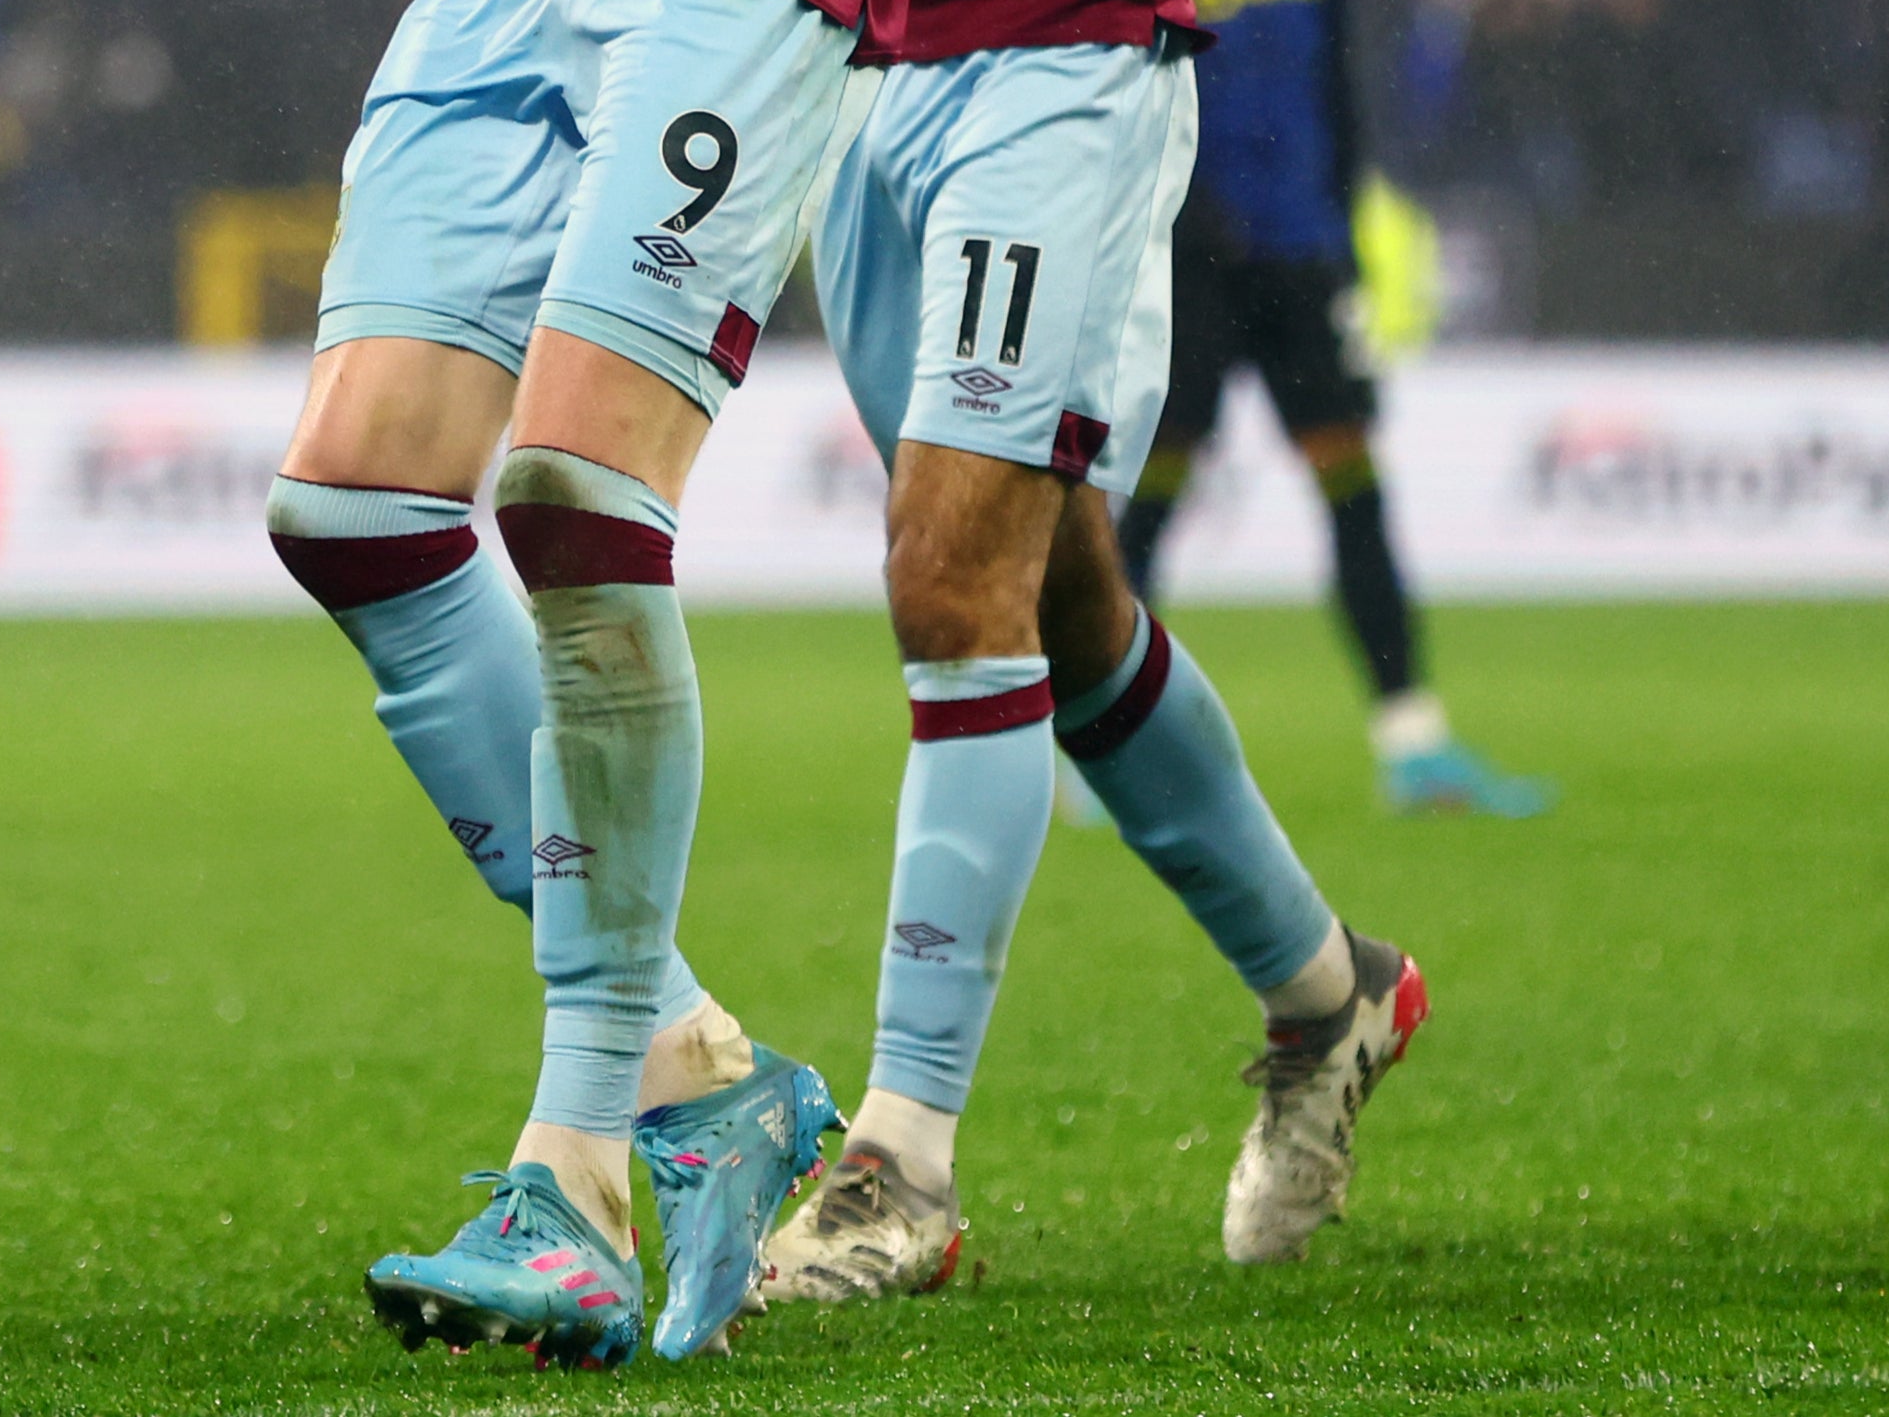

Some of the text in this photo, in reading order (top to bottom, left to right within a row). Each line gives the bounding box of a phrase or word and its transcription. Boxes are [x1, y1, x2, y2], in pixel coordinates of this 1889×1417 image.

[655, 108, 740, 236] 9
[632, 259, 683, 290] umbro
[955, 237, 1044, 368] 11
[952, 396, 1002, 416] umbro
